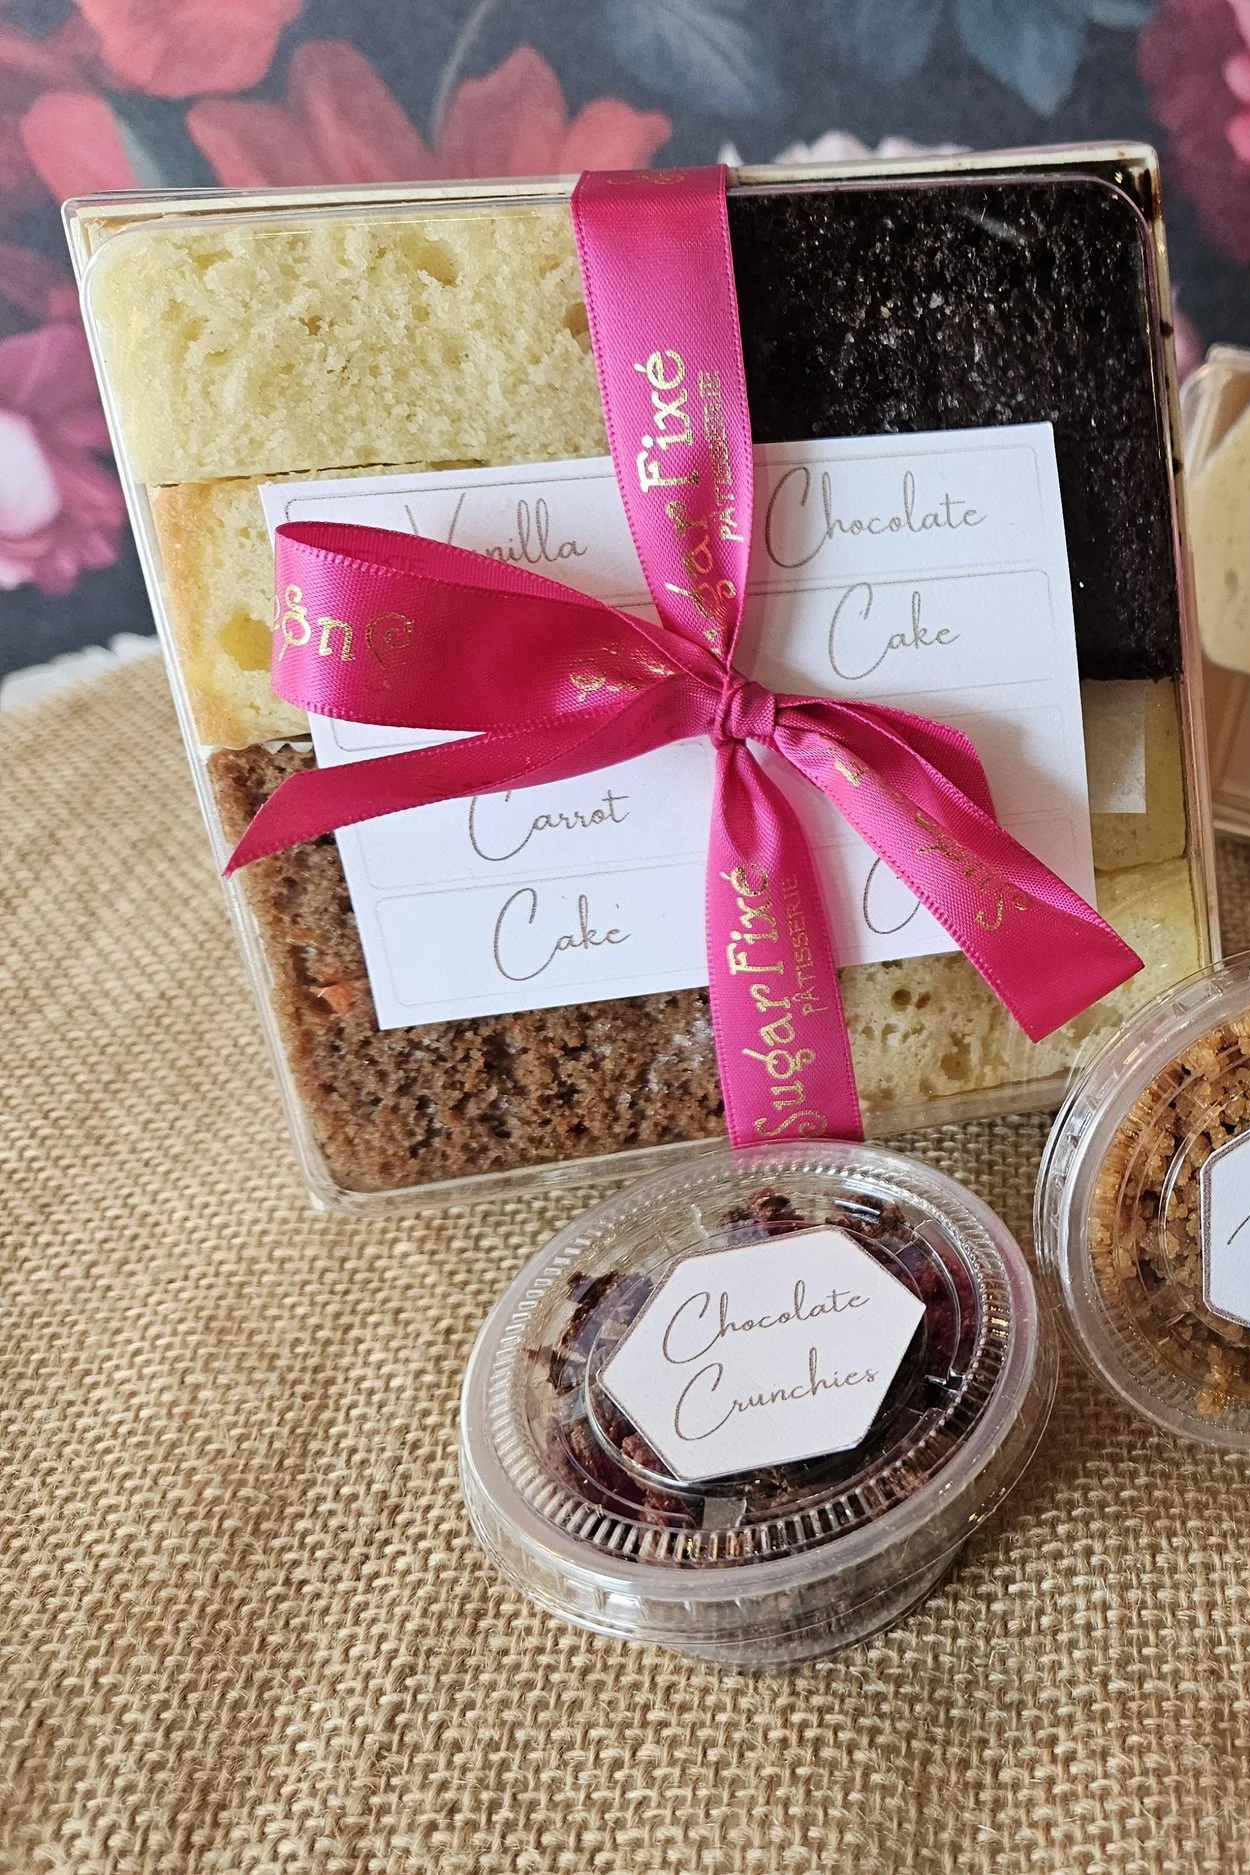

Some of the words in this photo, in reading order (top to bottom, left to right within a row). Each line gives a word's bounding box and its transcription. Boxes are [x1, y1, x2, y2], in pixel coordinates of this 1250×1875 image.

[633, 349, 699, 493] Fixé
[404, 492, 589, 564] Vnilla
[765, 466, 988, 569] Chocolate
[828, 582, 961, 681] Cake
[468, 789, 632, 861] Carrot
[493, 887, 632, 981] Cake
[720, 862, 784, 977] Fixé
[781, 873, 829, 1021] PATISSERIE
[742, 983, 829, 1138] Sugar
[662, 1279, 871, 1364] Chocolate
[674, 1347, 879, 1441] Crunchies
